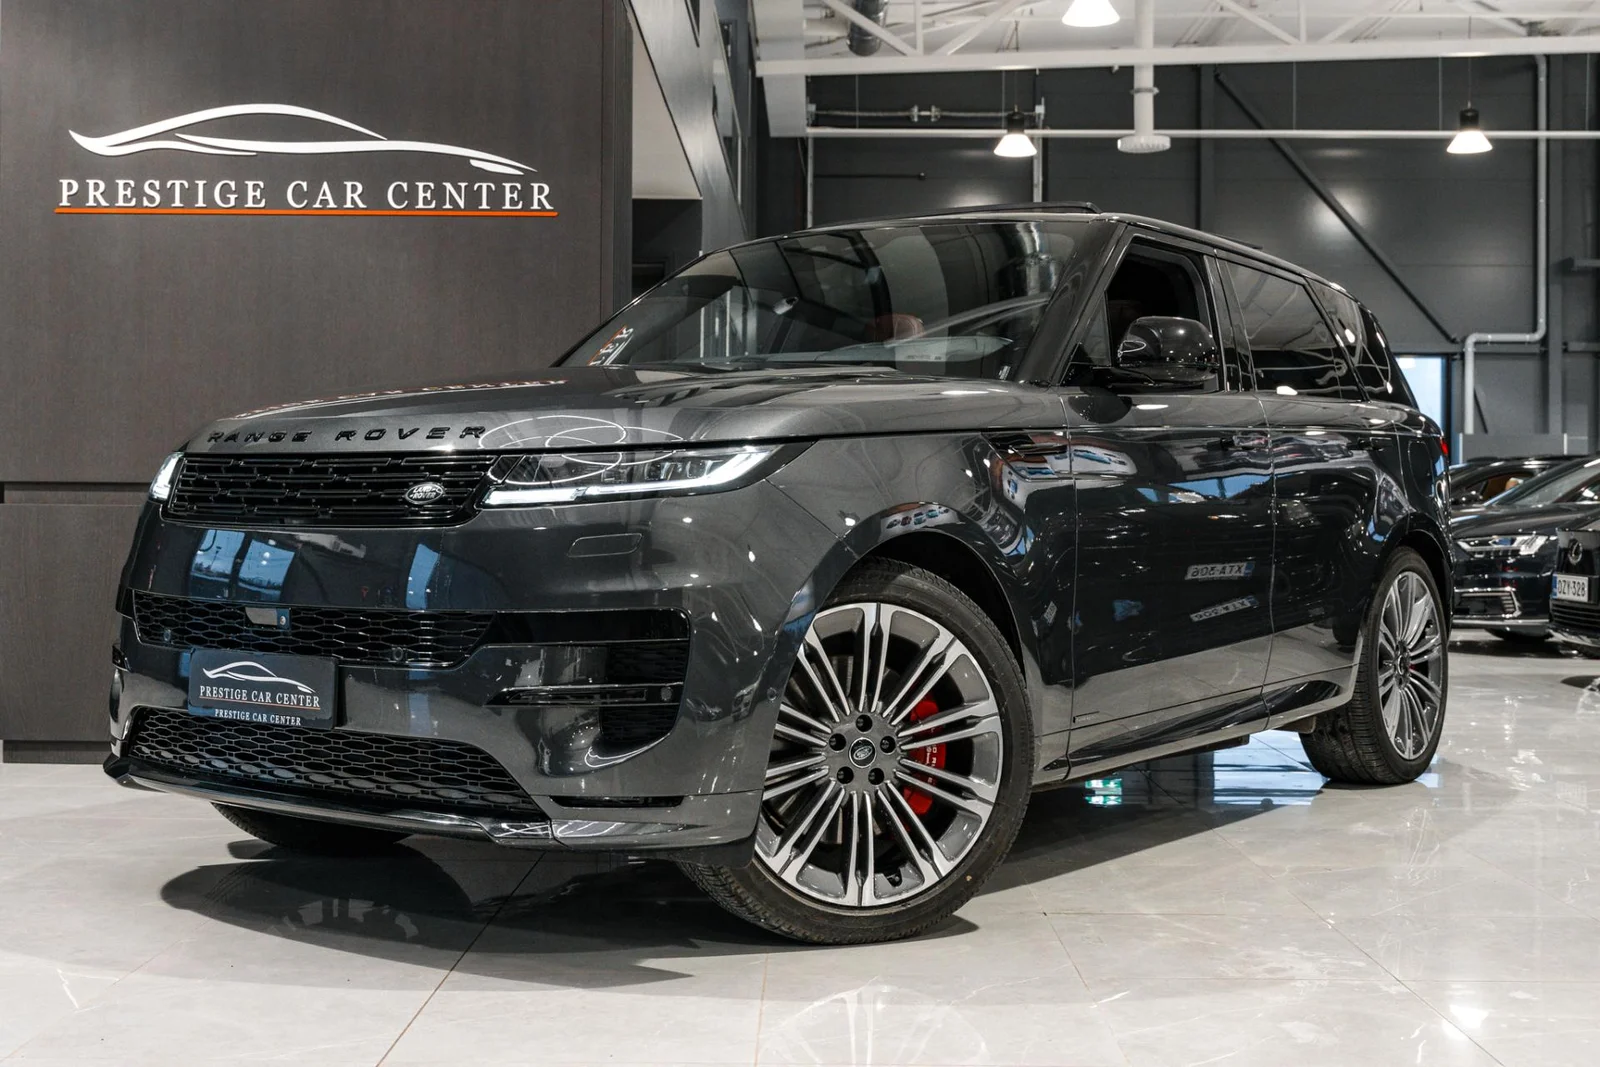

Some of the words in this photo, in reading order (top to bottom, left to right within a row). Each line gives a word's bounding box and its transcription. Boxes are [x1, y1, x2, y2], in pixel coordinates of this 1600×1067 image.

[59, 179, 267, 208] PRESTIGE
[286, 181, 367, 209] CAR
[387, 182, 554, 211] CENTER
[208, 430, 312, 443] RANGE
[335, 425, 487, 442] ROVER
[200, 685, 247, 700] PRESTIGE
[251, 690, 271, 703] CAR
[276, 694, 320, 707] CENTER
[215, 708, 249, 720] PRESTIGE
[252, 712, 268, 723] CAR
[270, 715, 301, 726] CENTER
